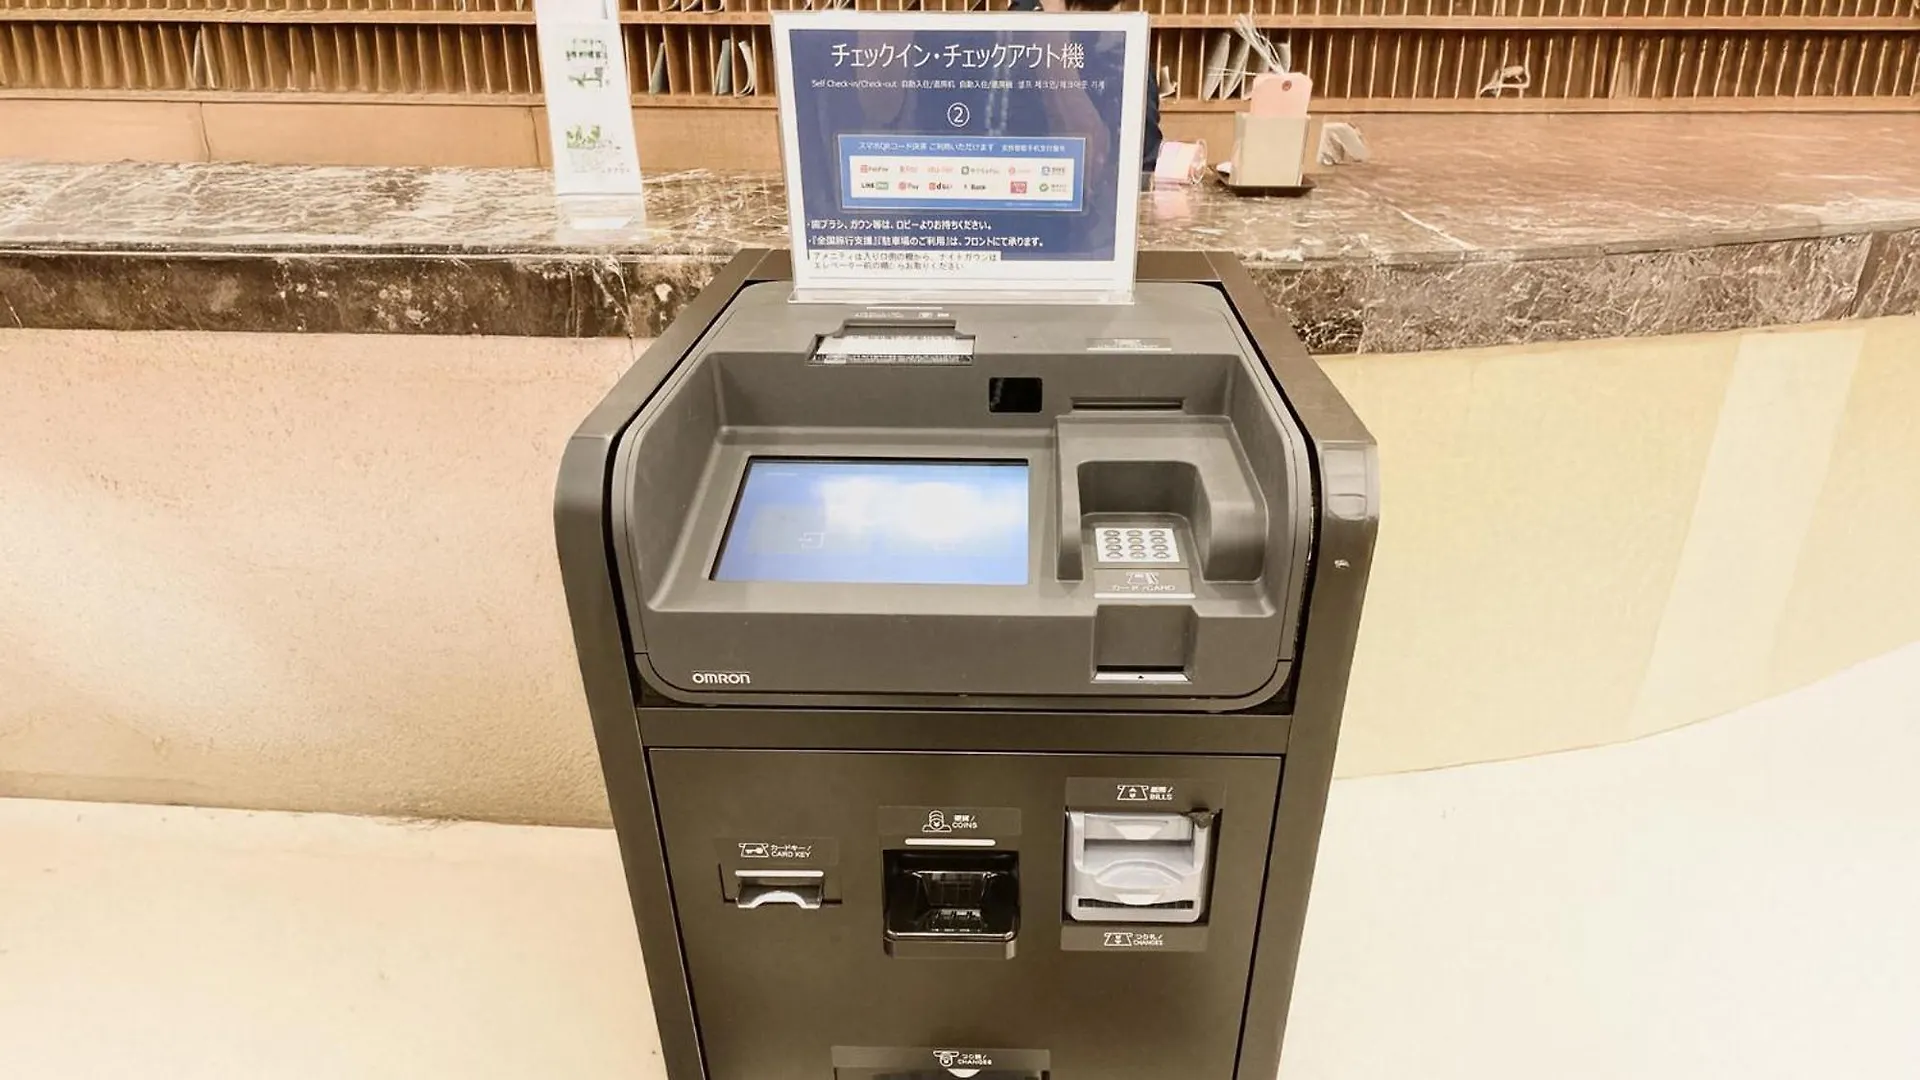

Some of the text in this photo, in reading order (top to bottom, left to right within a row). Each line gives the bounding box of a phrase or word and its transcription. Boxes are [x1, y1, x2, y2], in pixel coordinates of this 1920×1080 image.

[831, 43, 1085, 69] チェックイン・チェックアウト機
[811, 80, 825, 88] Self
[692, 673, 751, 684] OMRON
